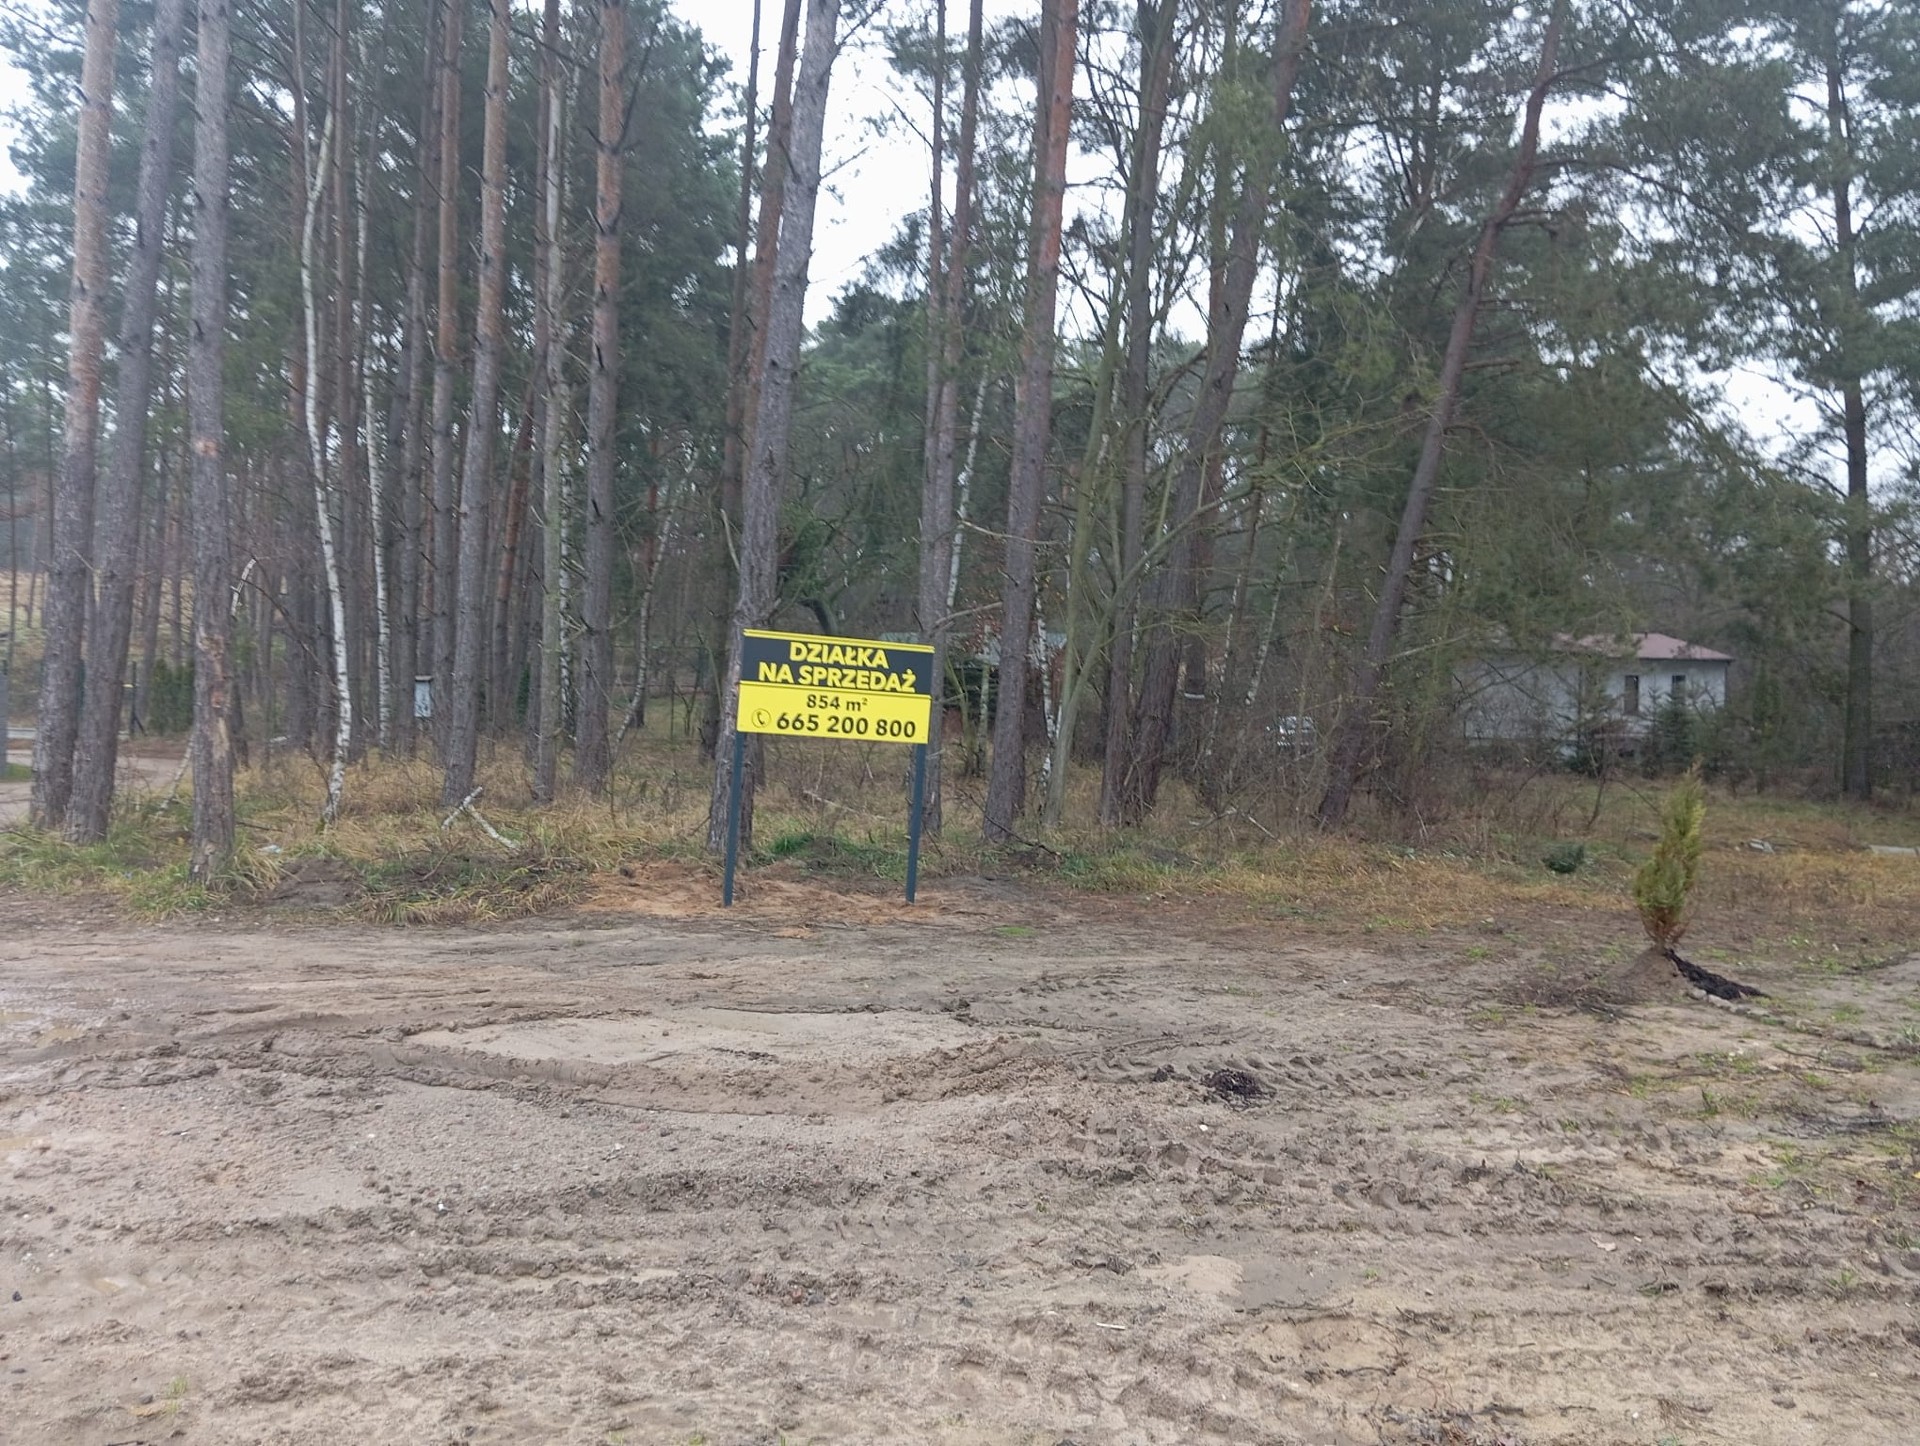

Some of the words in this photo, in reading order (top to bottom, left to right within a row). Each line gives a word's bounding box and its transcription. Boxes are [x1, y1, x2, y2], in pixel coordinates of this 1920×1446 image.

[789, 641, 889, 669] DZIAŁKA
[758, 662, 794, 684] NA
[798, 665, 917, 693] SPRZEDAŻ
[806, 694, 841, 710] 854
[776, 712, 819, 731] 665
[827, 715, 868, 735] 200
[875, 719, 916, 738] 800
